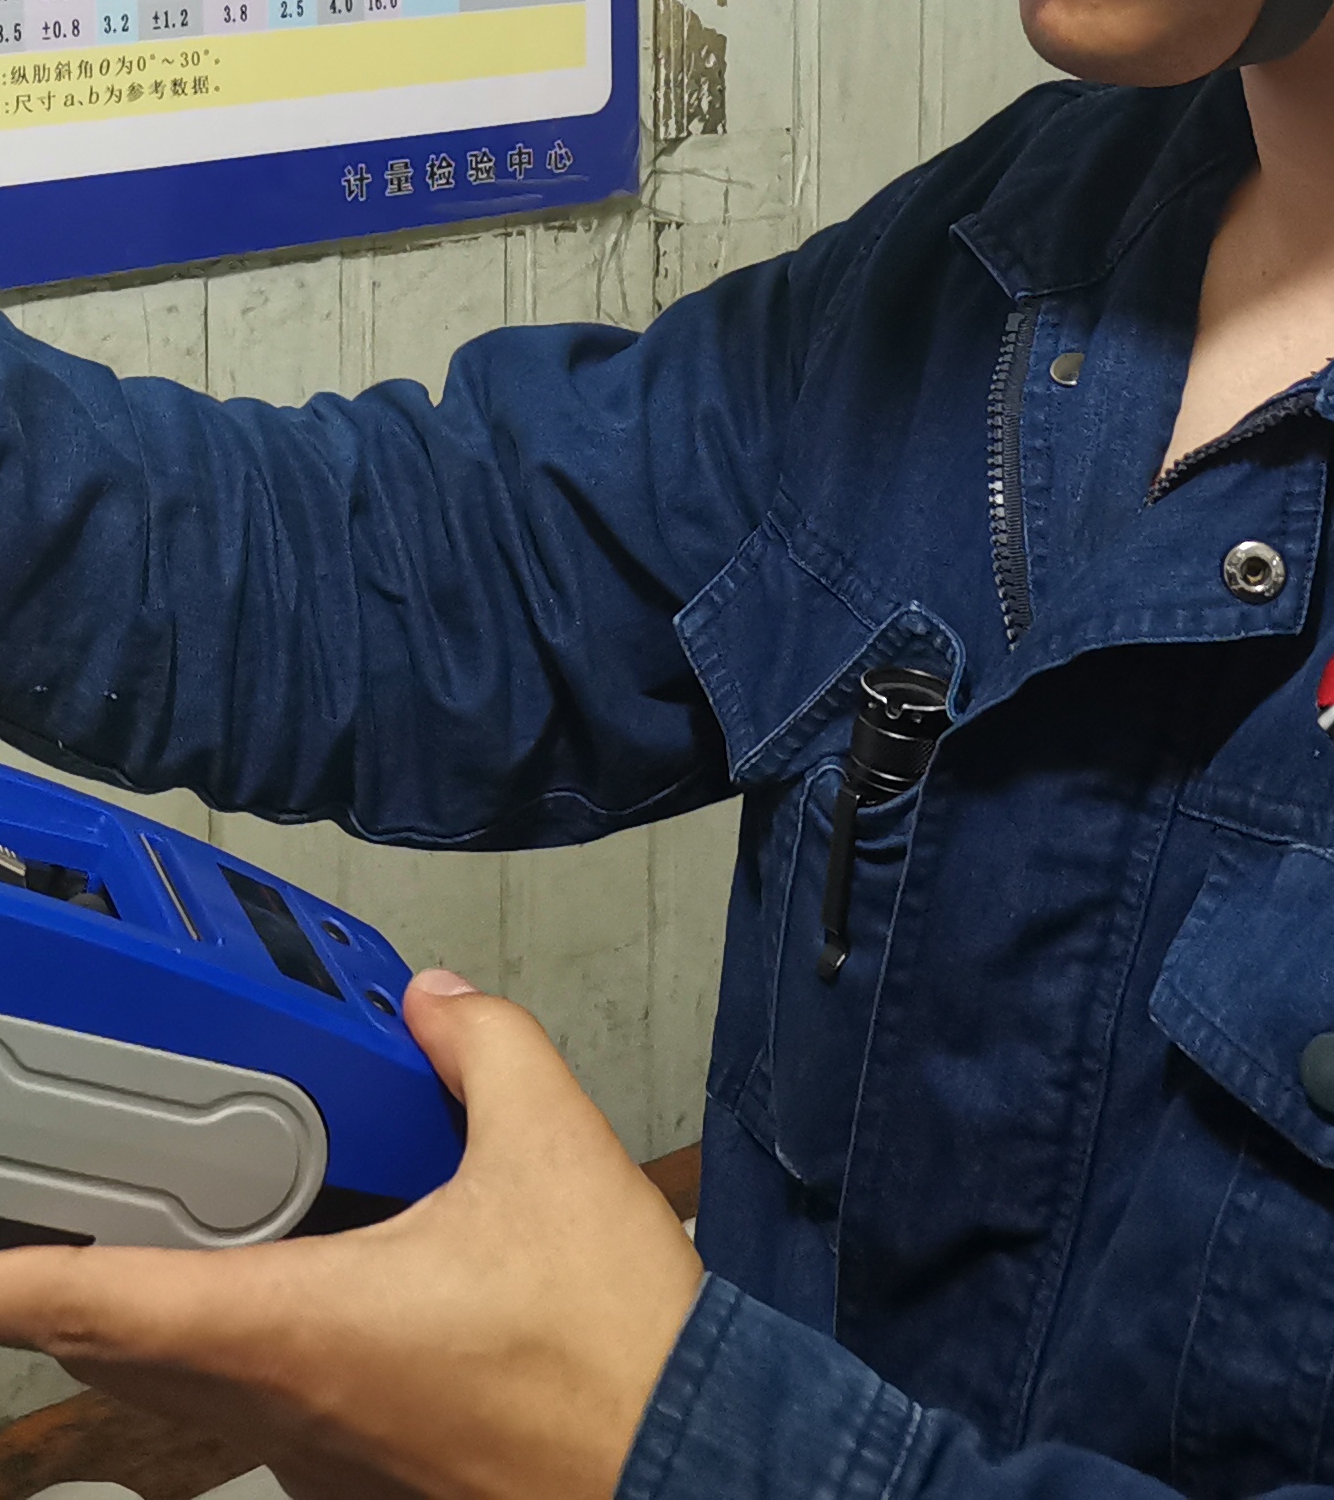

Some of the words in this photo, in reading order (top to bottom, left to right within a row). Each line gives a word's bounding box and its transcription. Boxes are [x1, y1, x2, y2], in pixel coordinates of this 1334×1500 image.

[41, 18, 81, 41] ±0.8
[341, 139, 573, 201] 计量检验中心
